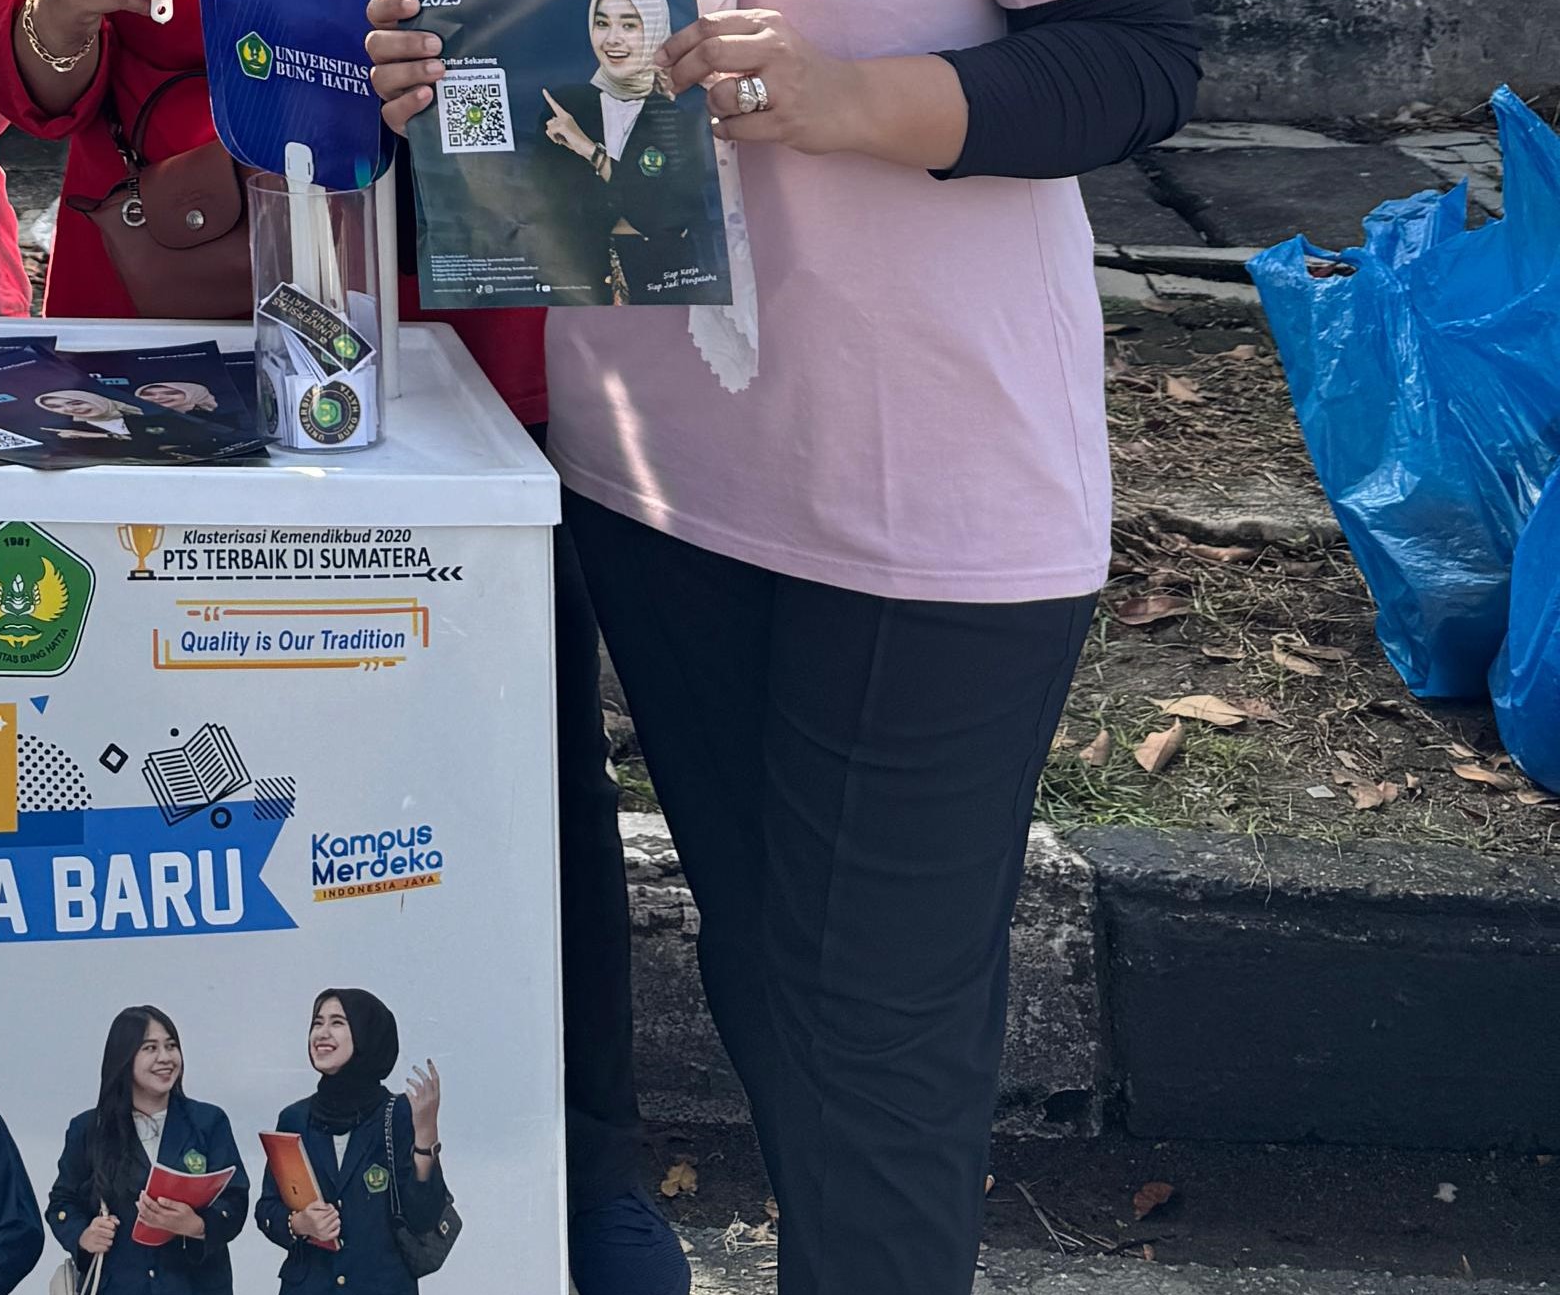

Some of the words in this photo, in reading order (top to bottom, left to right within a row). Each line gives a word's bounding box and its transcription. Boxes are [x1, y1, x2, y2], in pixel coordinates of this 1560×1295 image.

[275, 45, 369, 80] UNIVERSITAS
[275, 61, 315, 84] BUNG
[321, 72, 370, 97] HATTA
[3, 537, 31, 547] 1981
[183, 530, 267, 544] Klasterisasi
[270, 529, 371, 544] Kemendikbud
[376, 529, 411, 543] 2020
[163, 549, 198, 570] PTS
[203, 548, 288, 570] TERBAIK
[294, 548, 314, 569] DI
[320, 547, 431, 569] SUMATERA
[20, 649, 46, 664] BUNG
[46, 628, 68, 654] HATTA
[181, 631, 250, 656] Quality
[256, 630, 272, 652] is
[279, 631, 314, 652] Our
[321, 628, 405, 650] Tradition
[312, 825, 432, 860] Kampus
[312, 848, 443, 886] Merdeka
[52, 848, 243, 933] BARU
[323, 882, 396, 899] INDONESIA
[403, 876, 435, 888] JAYA
